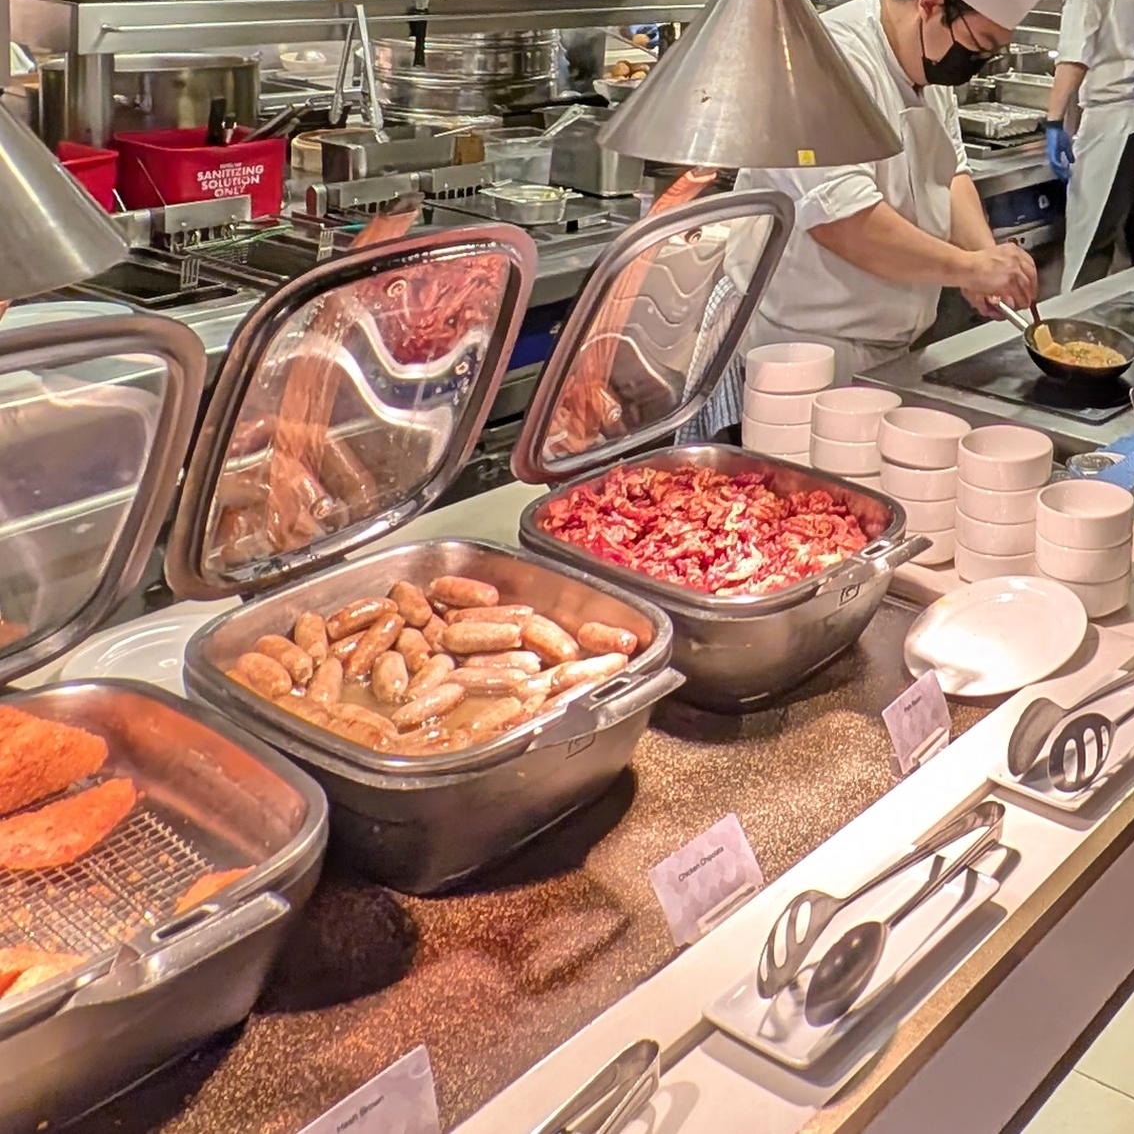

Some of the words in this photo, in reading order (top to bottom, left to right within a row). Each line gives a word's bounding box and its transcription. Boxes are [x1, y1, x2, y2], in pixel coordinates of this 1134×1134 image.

[196, 164, 264, 182] SANITIZING
[201, 174, 260, 191] SOLUTION
[214, 183, 246, 198] ONLY
